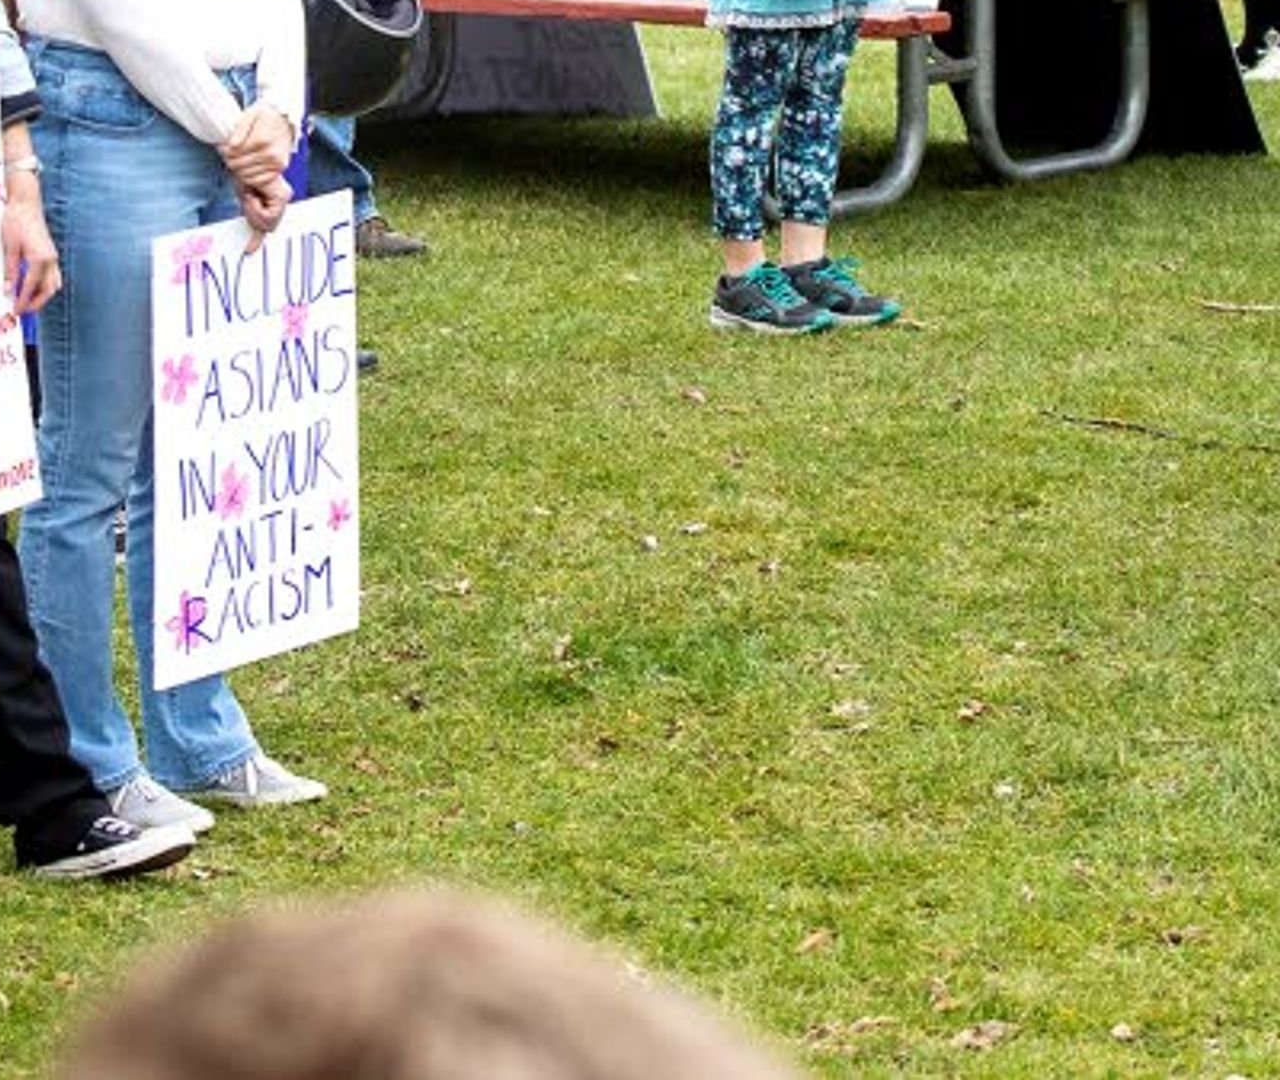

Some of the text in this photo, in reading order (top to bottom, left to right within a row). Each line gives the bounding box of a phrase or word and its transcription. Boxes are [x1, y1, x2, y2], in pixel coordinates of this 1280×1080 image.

[185, 222, 354, 338] INCLUDE
[196, 324, 351, 428] ASIANS
[178, 418, 344, 521] IN YOUR
[205, 507, 317, 588] ANTI-
[184, 555, 335, 655] RACISM
